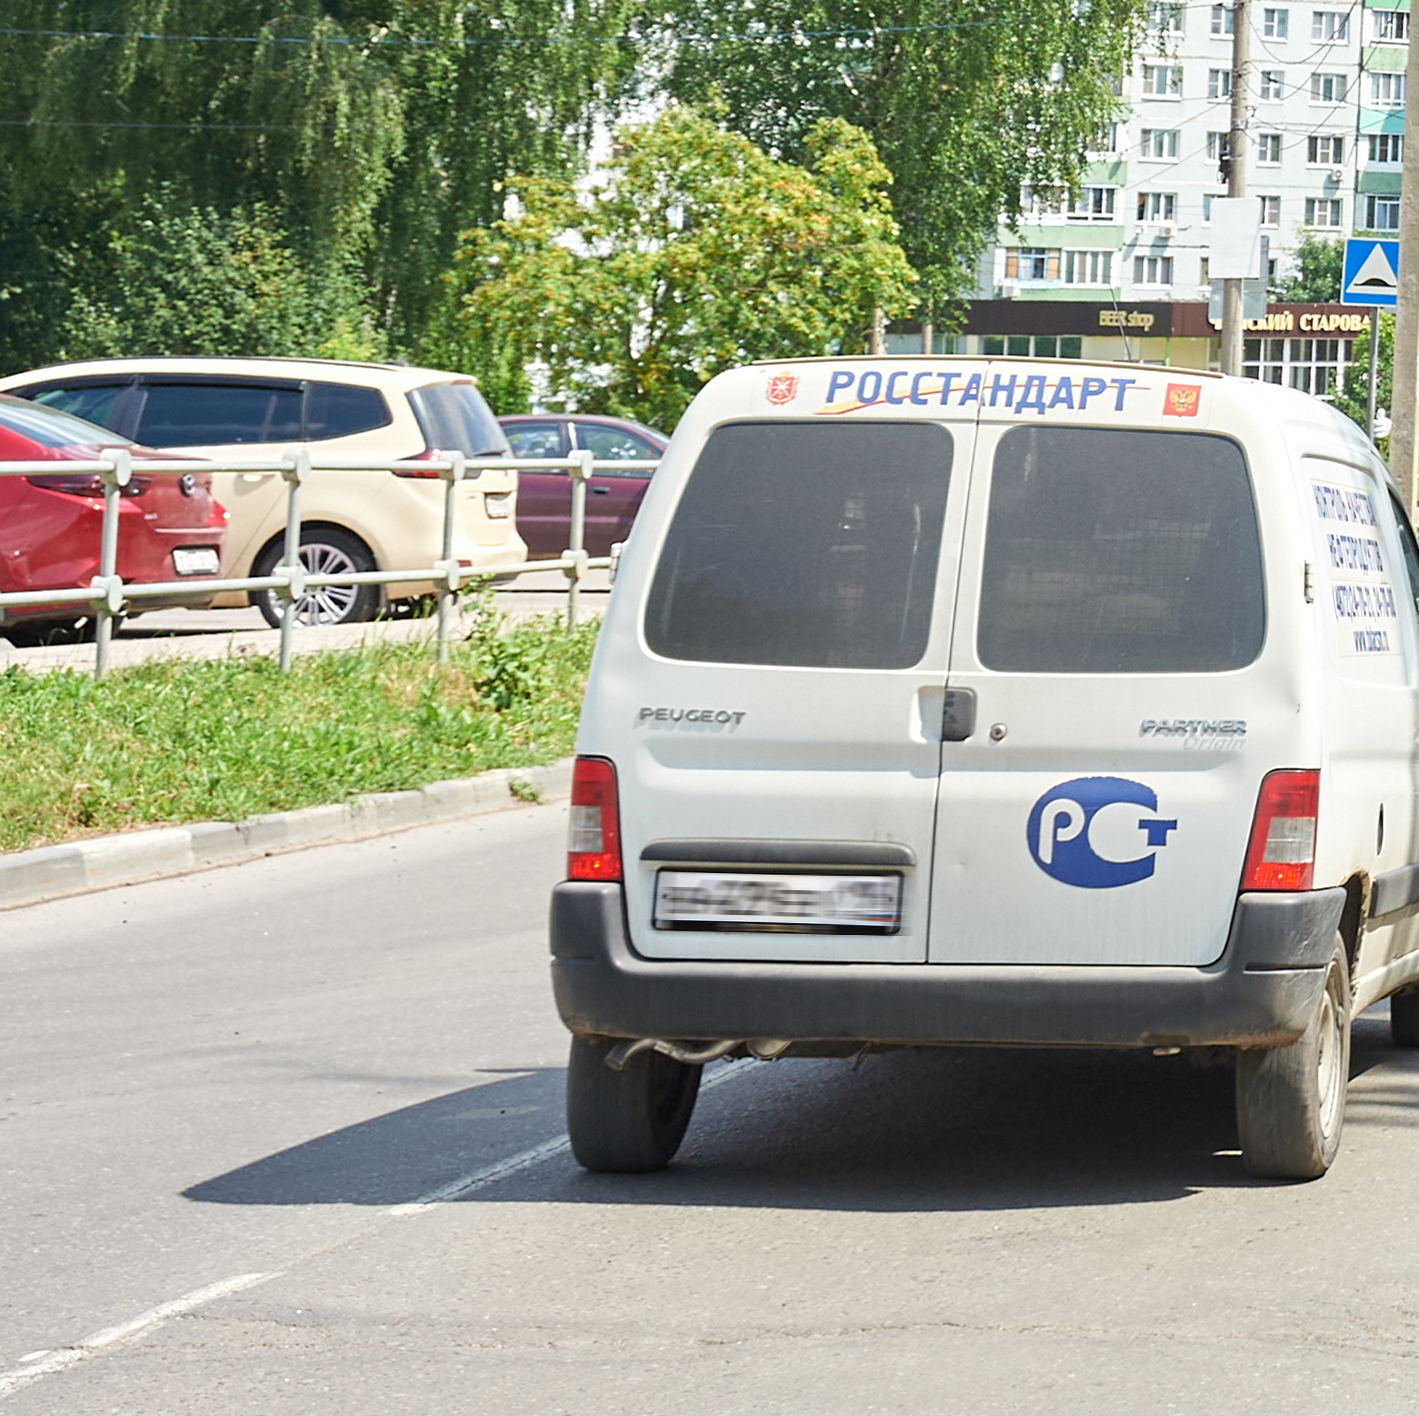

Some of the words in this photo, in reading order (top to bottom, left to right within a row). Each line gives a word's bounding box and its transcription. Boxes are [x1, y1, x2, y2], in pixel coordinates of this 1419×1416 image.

[1099, 310, 1127, 327] BEER
[1127, 310, 1154, 332] shop
[826, 370, 1136, 416] РОССТАНДАРТ
[639, 706, 747, 725] PEUGEOT
[1140, 718, 1247, 735] PARTNER
